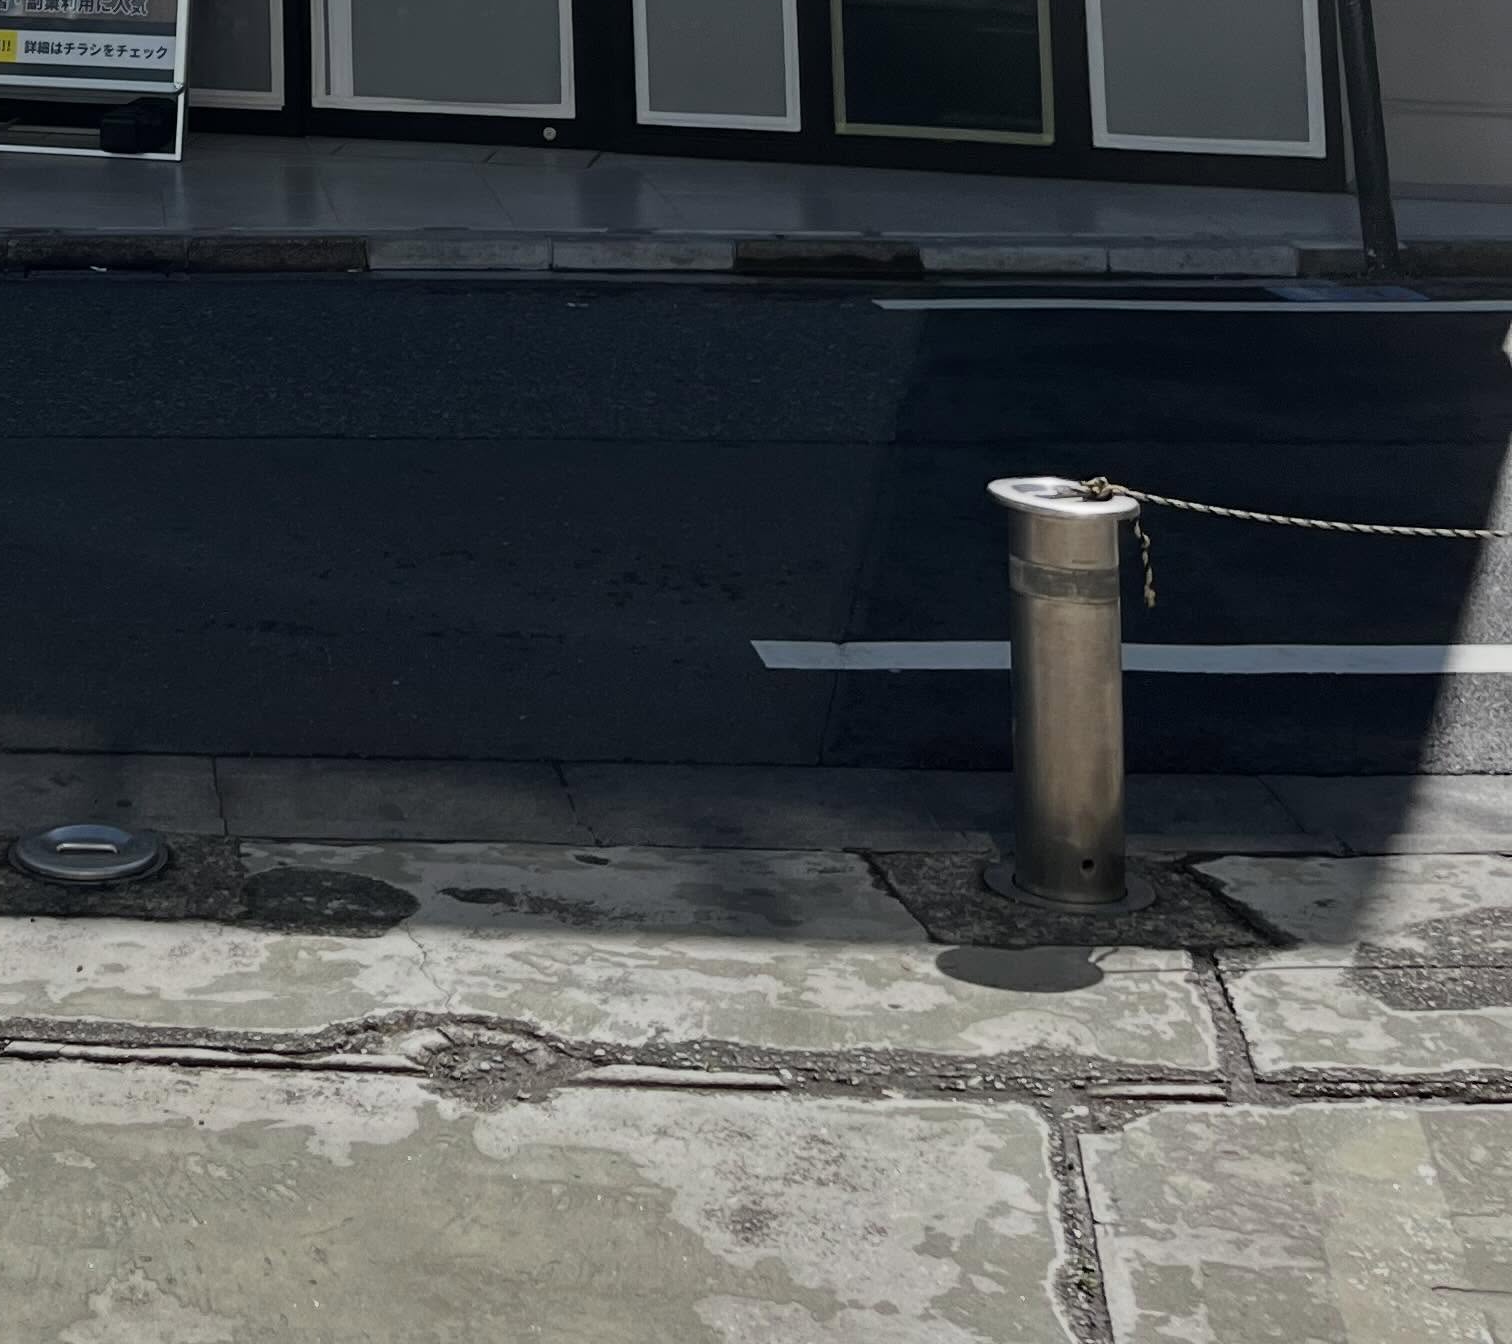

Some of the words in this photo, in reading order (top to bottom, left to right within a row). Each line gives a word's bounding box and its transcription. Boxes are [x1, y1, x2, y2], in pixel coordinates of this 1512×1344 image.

[24, 39, 168, 61] 詳細はチラシをチェック
